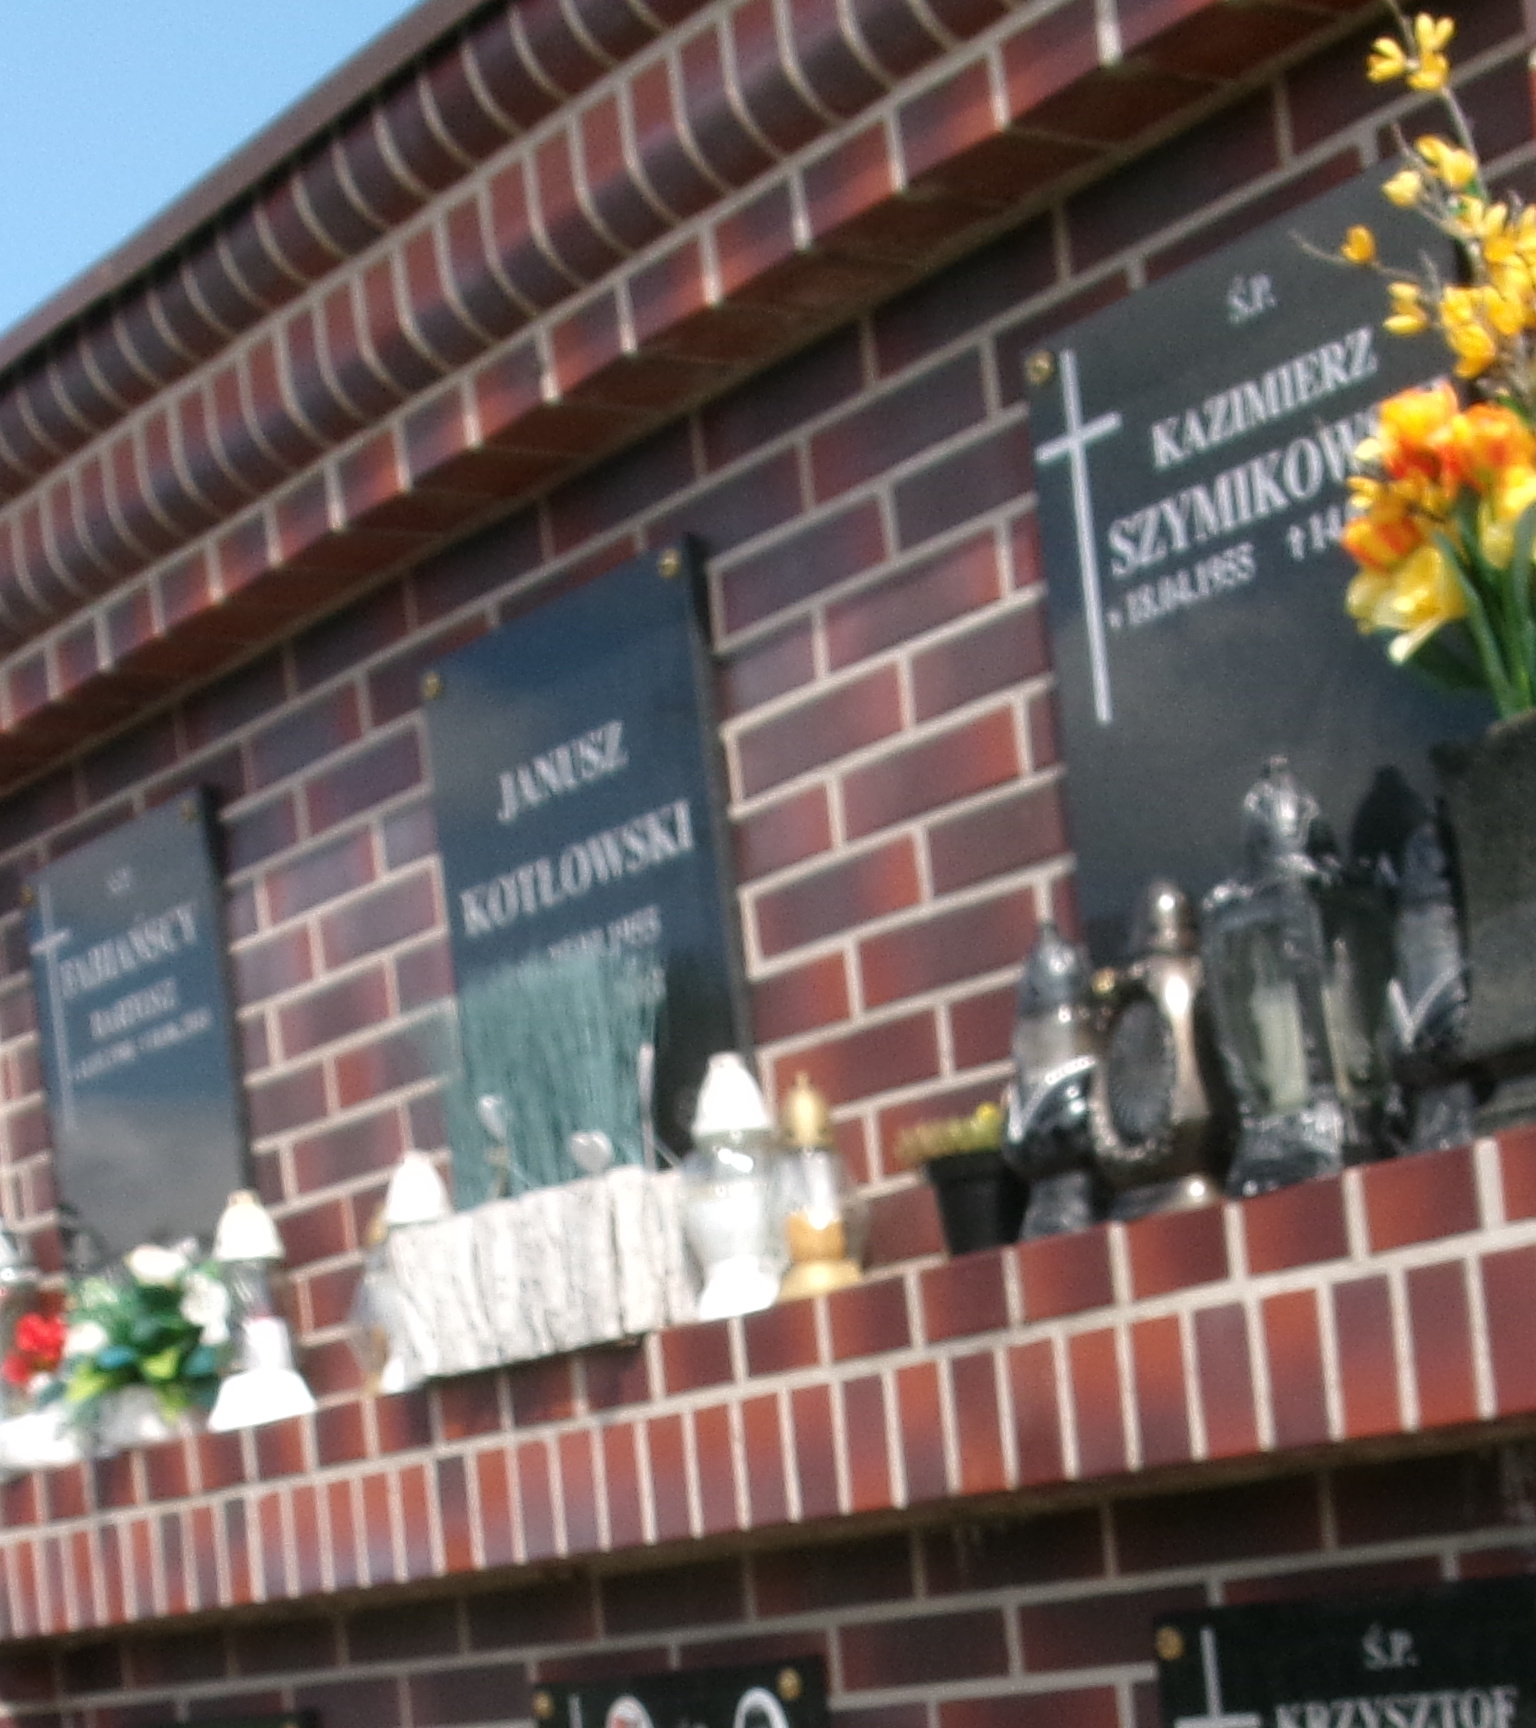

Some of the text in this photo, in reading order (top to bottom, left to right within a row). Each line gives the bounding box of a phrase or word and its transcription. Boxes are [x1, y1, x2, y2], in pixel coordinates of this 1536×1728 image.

[1151, 326, 1380, 472] KAZIMIERZ
[1107, 405, 1384, 578] SZYMIKOW
[497, 720, 629, 825] JANUSZ
